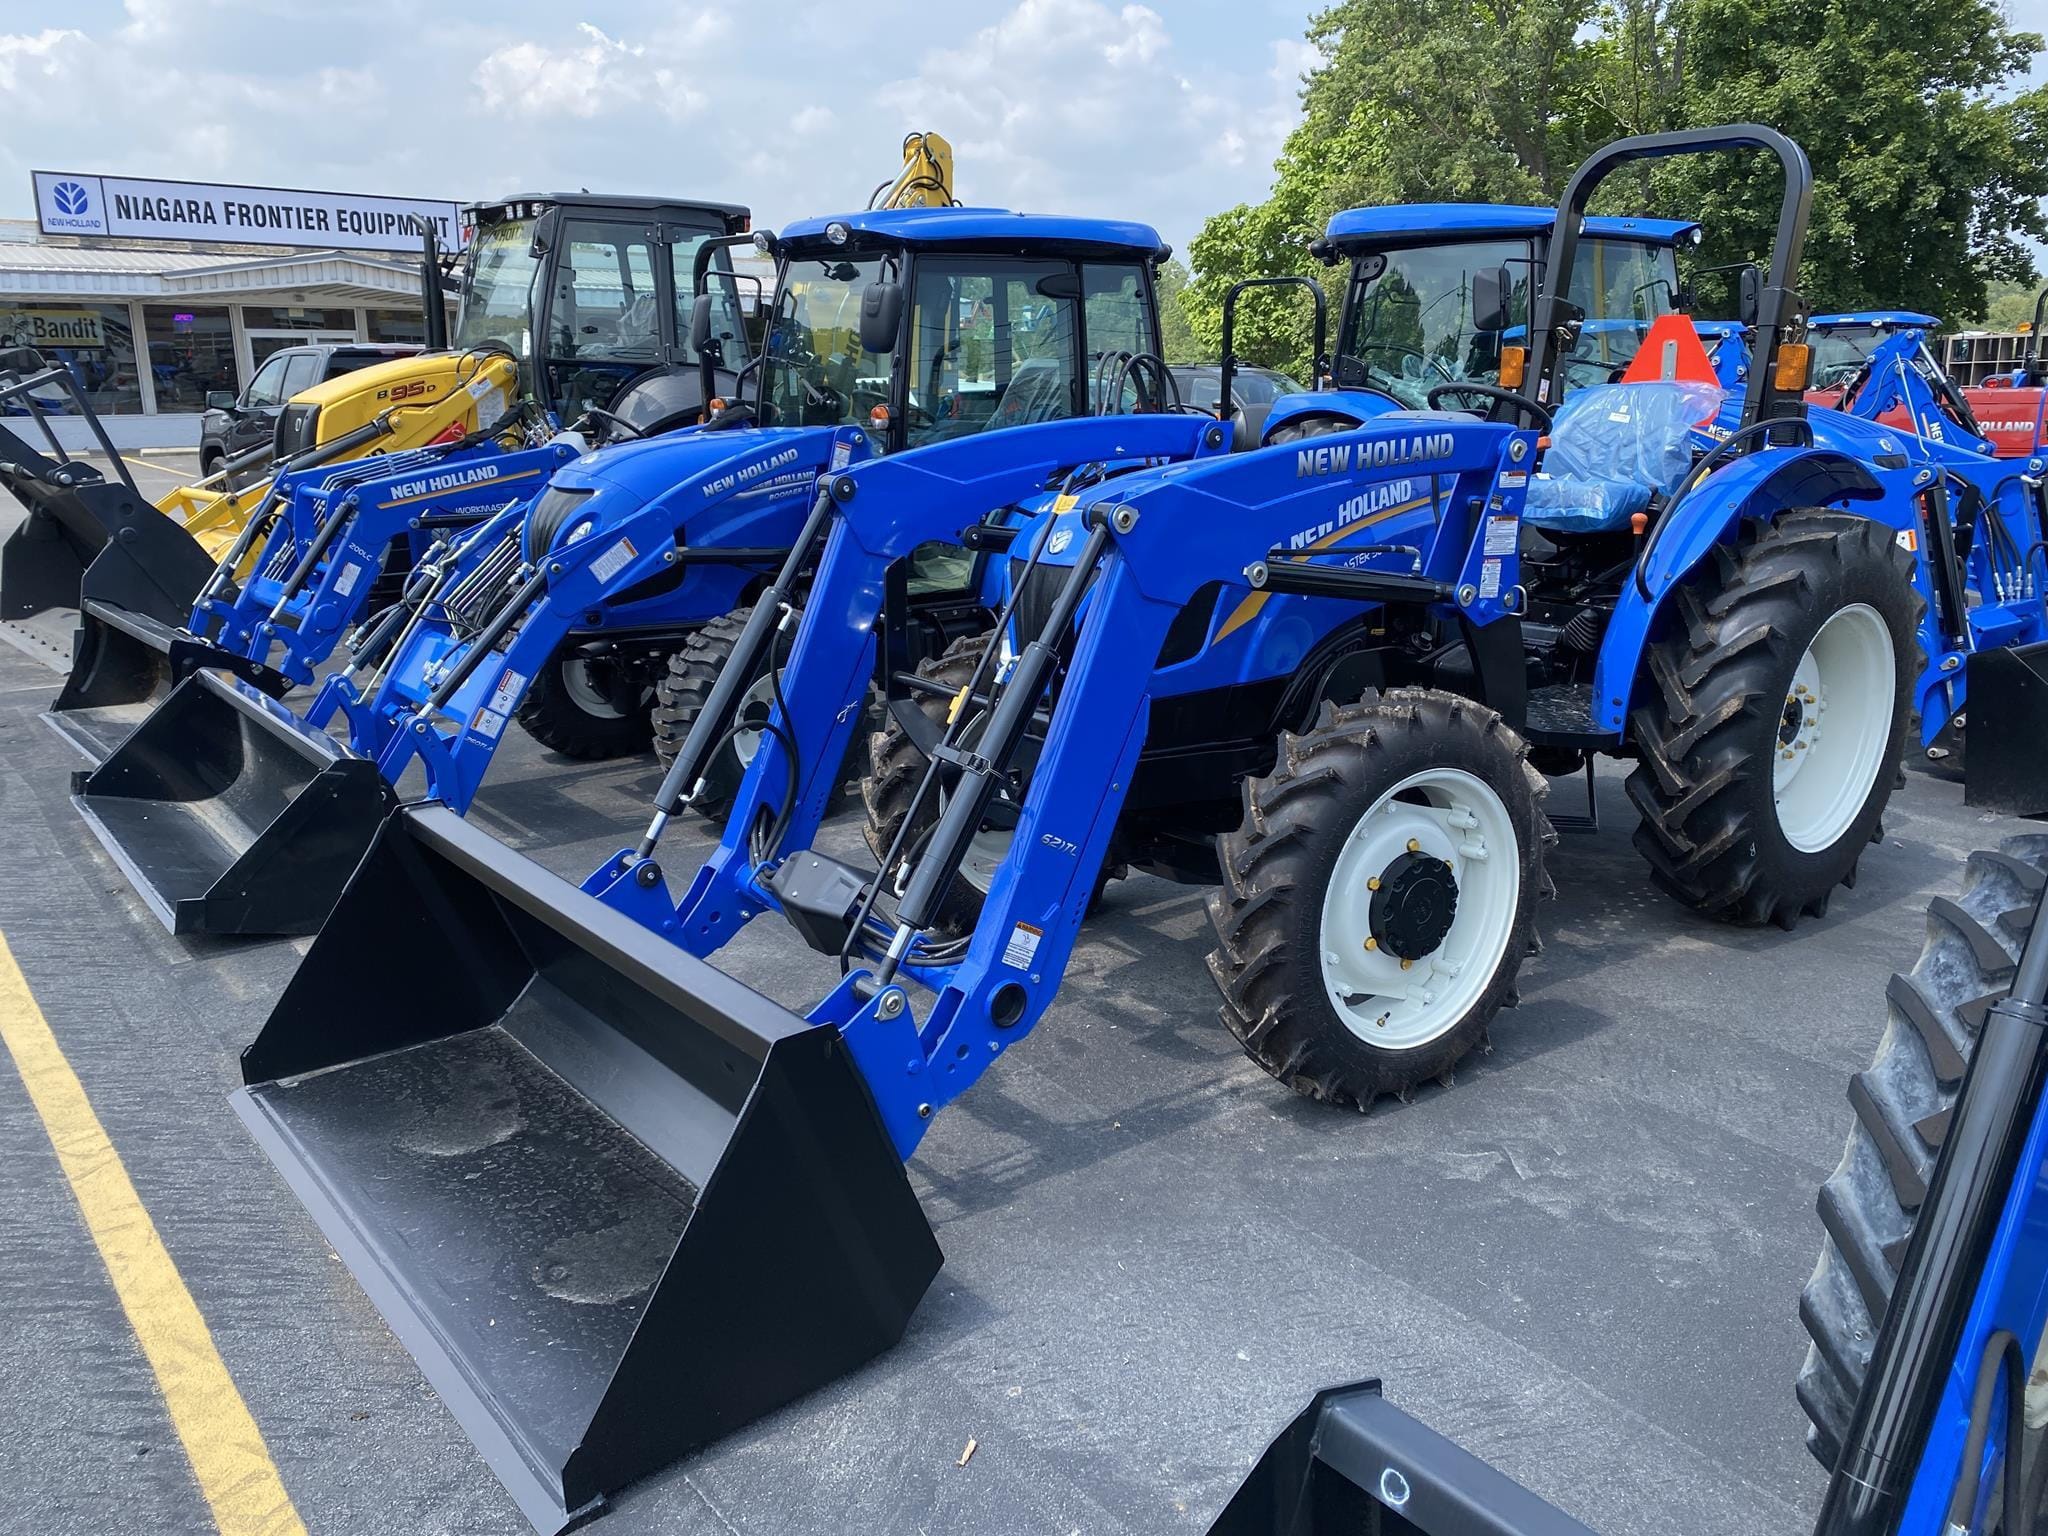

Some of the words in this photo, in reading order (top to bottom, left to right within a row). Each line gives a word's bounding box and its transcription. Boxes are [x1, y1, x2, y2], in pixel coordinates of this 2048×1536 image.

[47, 217, 65, 227] NEW
[65, 219, 101, 228] HOLLAND
[115, 194, 217, 225] NIAGARA
[224, 201, 329, 232] FRONTIER
[33, 316, 98, 339] Bandit
[1977, 421, 2035, 432] OLLAND
[702, 474, 735, 498] NEW
[736, 448, 799, 483] HOLLAND
[1296, 447, 1350, 478] NEW
[1356, 433, 1455, 471] HOLLAND
[390, 480, 427, 500] NEW
[430, 464, 499, 492] HOLLAND
[774, 470, 815, 486] HOLLAND
[1338, 479, 1412, 527] HOLLAND
